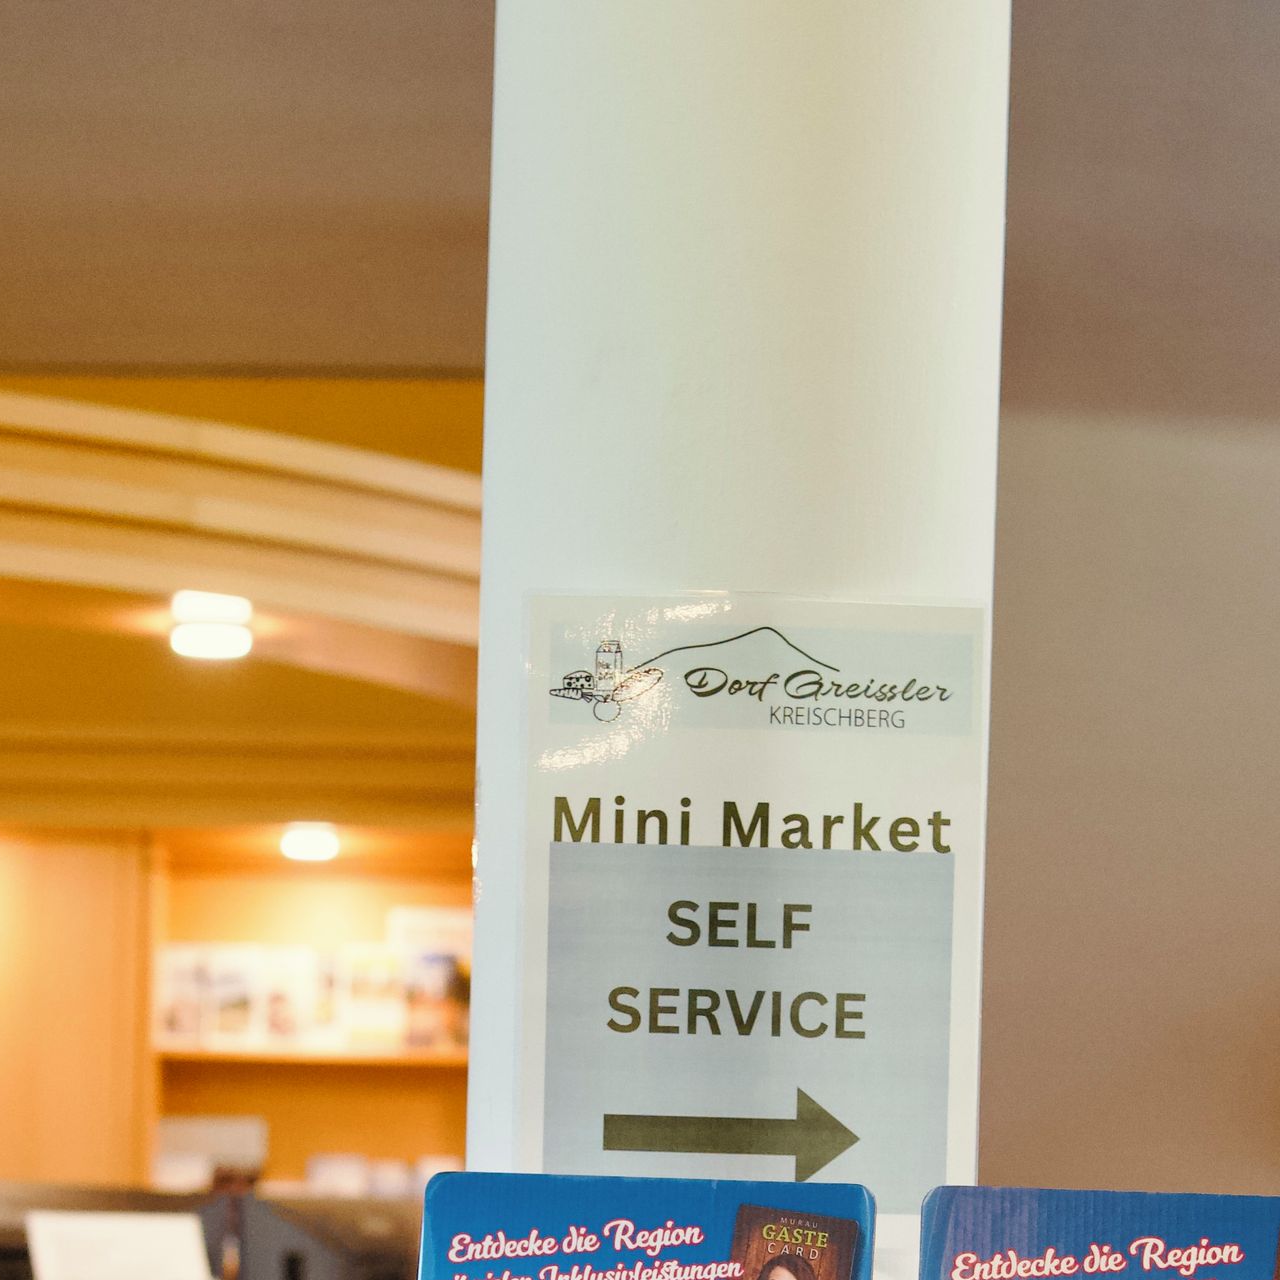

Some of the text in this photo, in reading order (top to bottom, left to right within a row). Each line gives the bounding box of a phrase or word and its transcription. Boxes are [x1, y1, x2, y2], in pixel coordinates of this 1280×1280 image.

[684, 668, 953, 702] Dorf Greissler
[770, 706, 905, 728] KREISCHBERG
[552, 795, 952, 853] Mini Market
[665, 900, 813, 949] SELF
[606, 986, 867, 1039] SERVICE
[447, 1219, 704, 1263] Entdecke die Region
[780, 1217, 818, 1228] MURAU
[767, 1242, 819, 1260] CARD
[1083, 1242, 1126, 1275] die
[1129, 1236, 1244, 1277] Region
